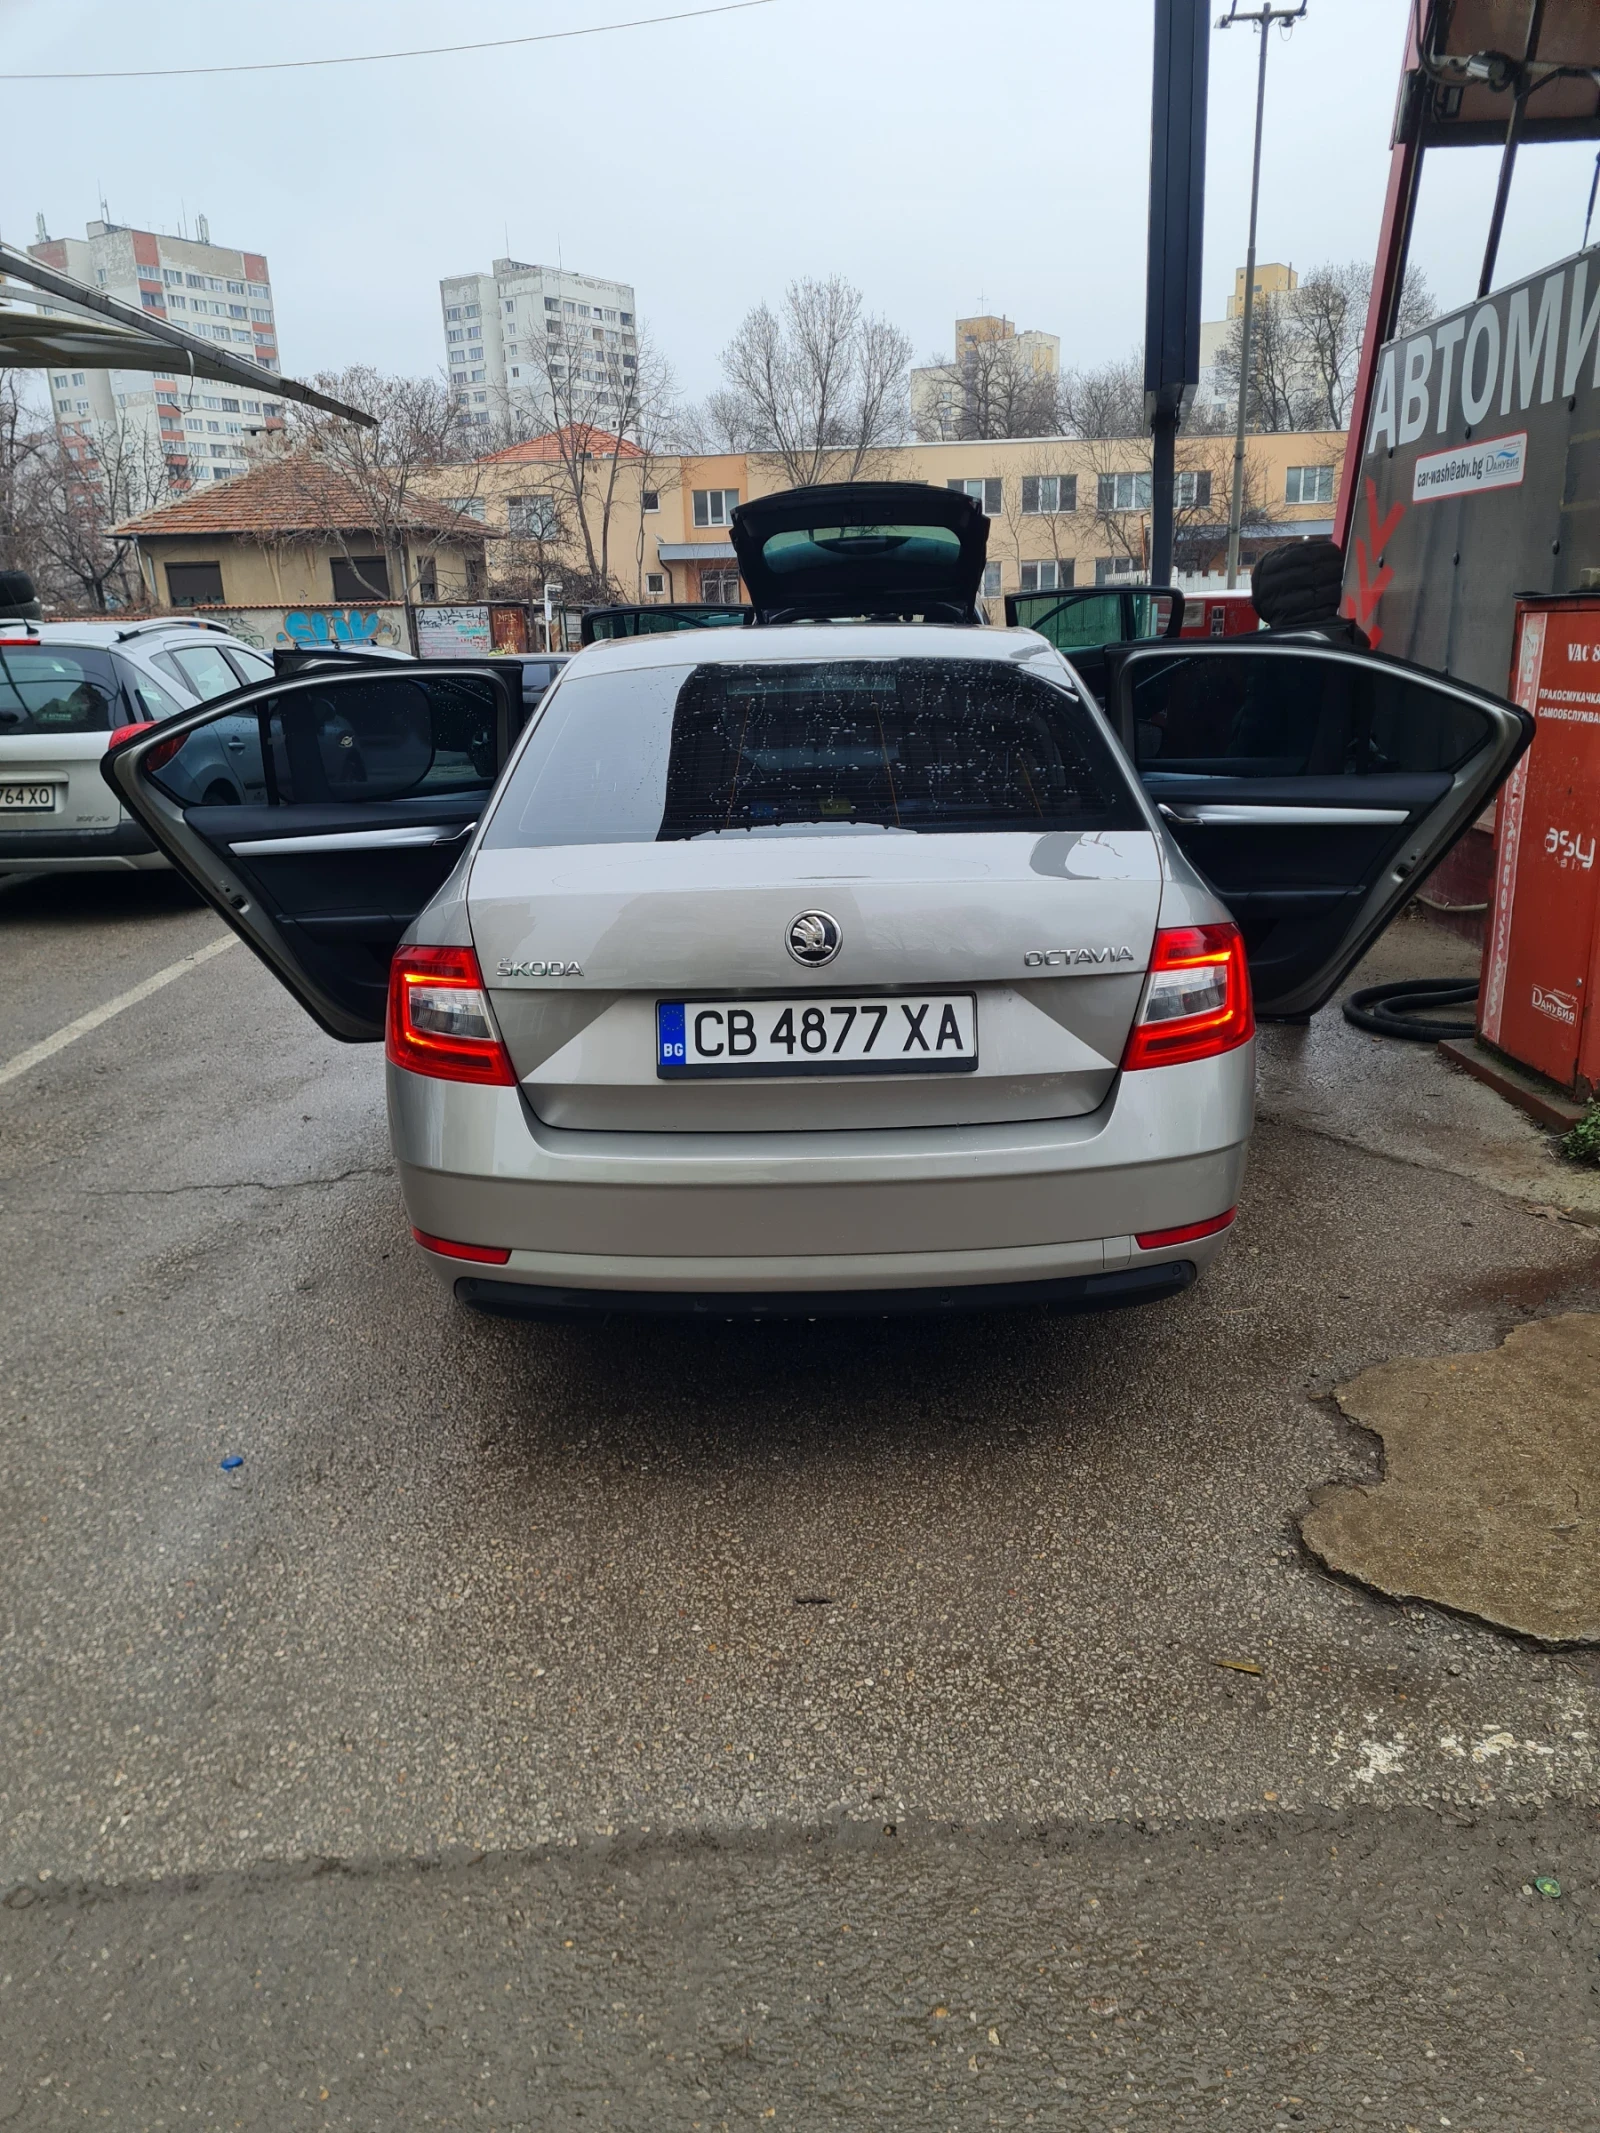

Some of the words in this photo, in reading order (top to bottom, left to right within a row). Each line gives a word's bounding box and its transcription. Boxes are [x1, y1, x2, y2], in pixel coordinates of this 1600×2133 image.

[1417, 457, 1484, 488] car-wash@abv.bg
[1567, 643, 1590, 662] VAC
[28, 787, 50, 804] XO
[1024, 946, 1134, 967] OCTAVIA
[496, 957, 584, 977] ŠKODA
[694, 1009, 757, 1057] CB
[770, 1005, 888, 1055] 4877
[900, 1003, 964, 1052] XA
[663, 1043, 684, 1057] BG
